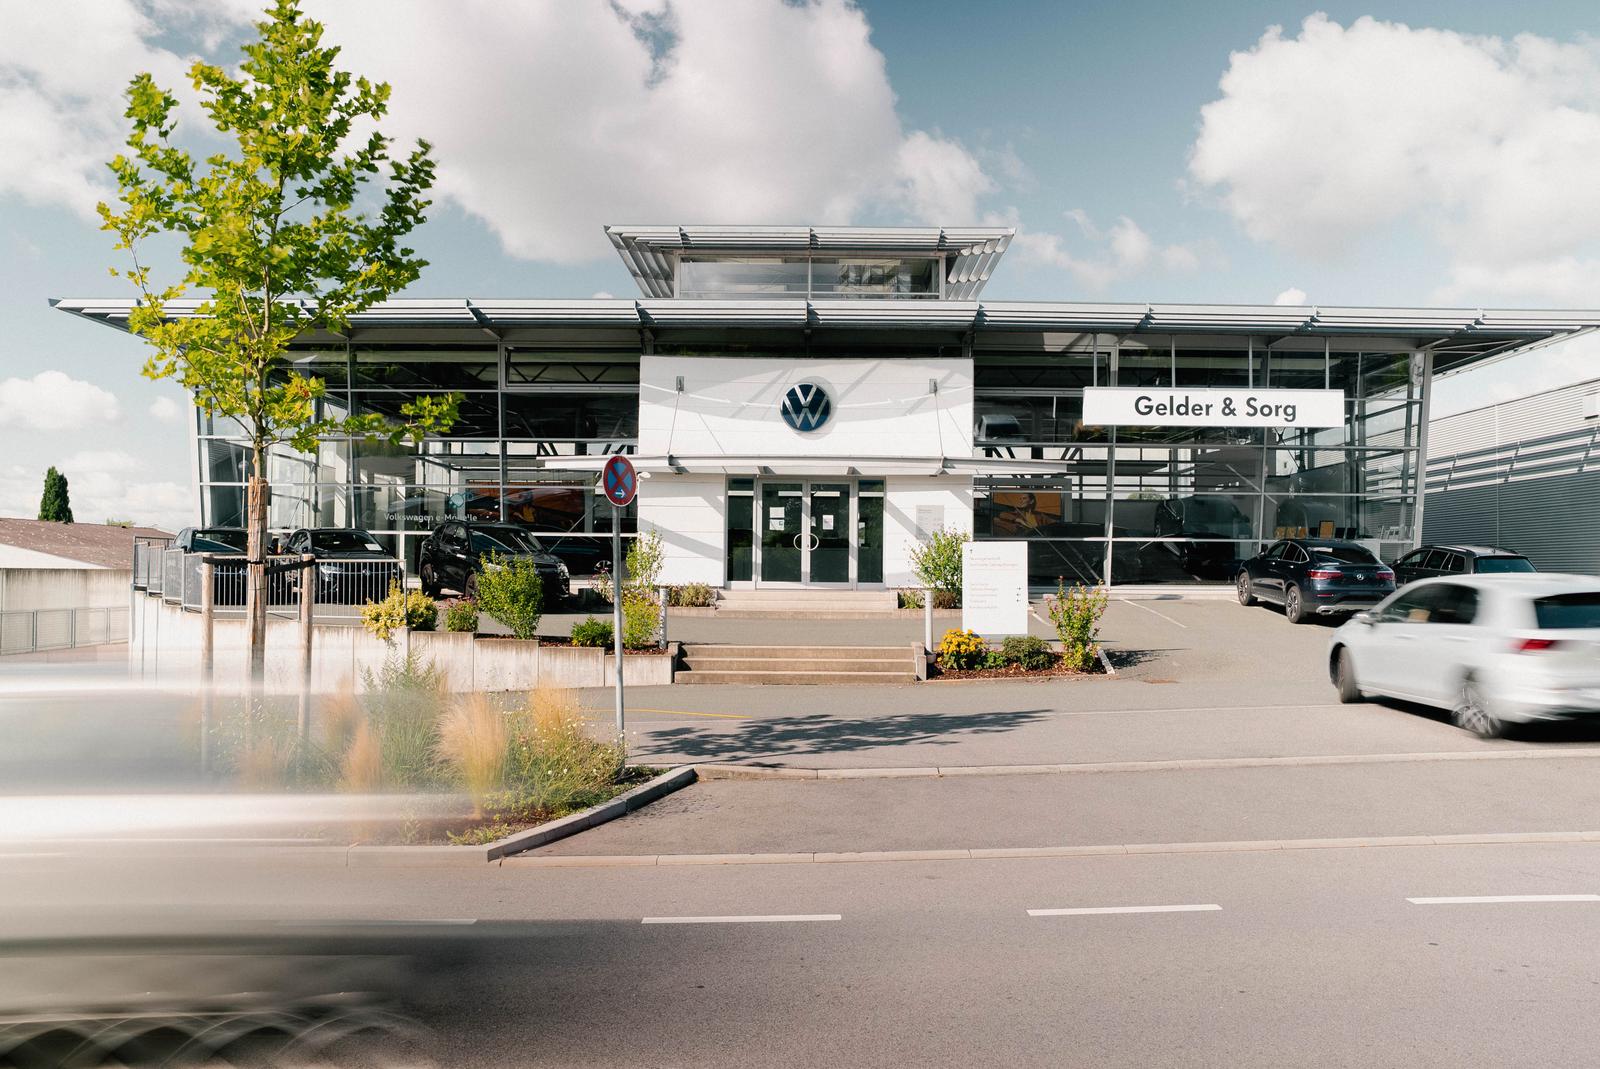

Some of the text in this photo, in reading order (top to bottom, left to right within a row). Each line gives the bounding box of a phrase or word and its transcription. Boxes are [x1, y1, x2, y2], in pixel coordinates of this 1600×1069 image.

[1134, 395, 1297, 422] Gelder & Sorg
[384, 513, 478, 523] Volkswagen e-Moelle
